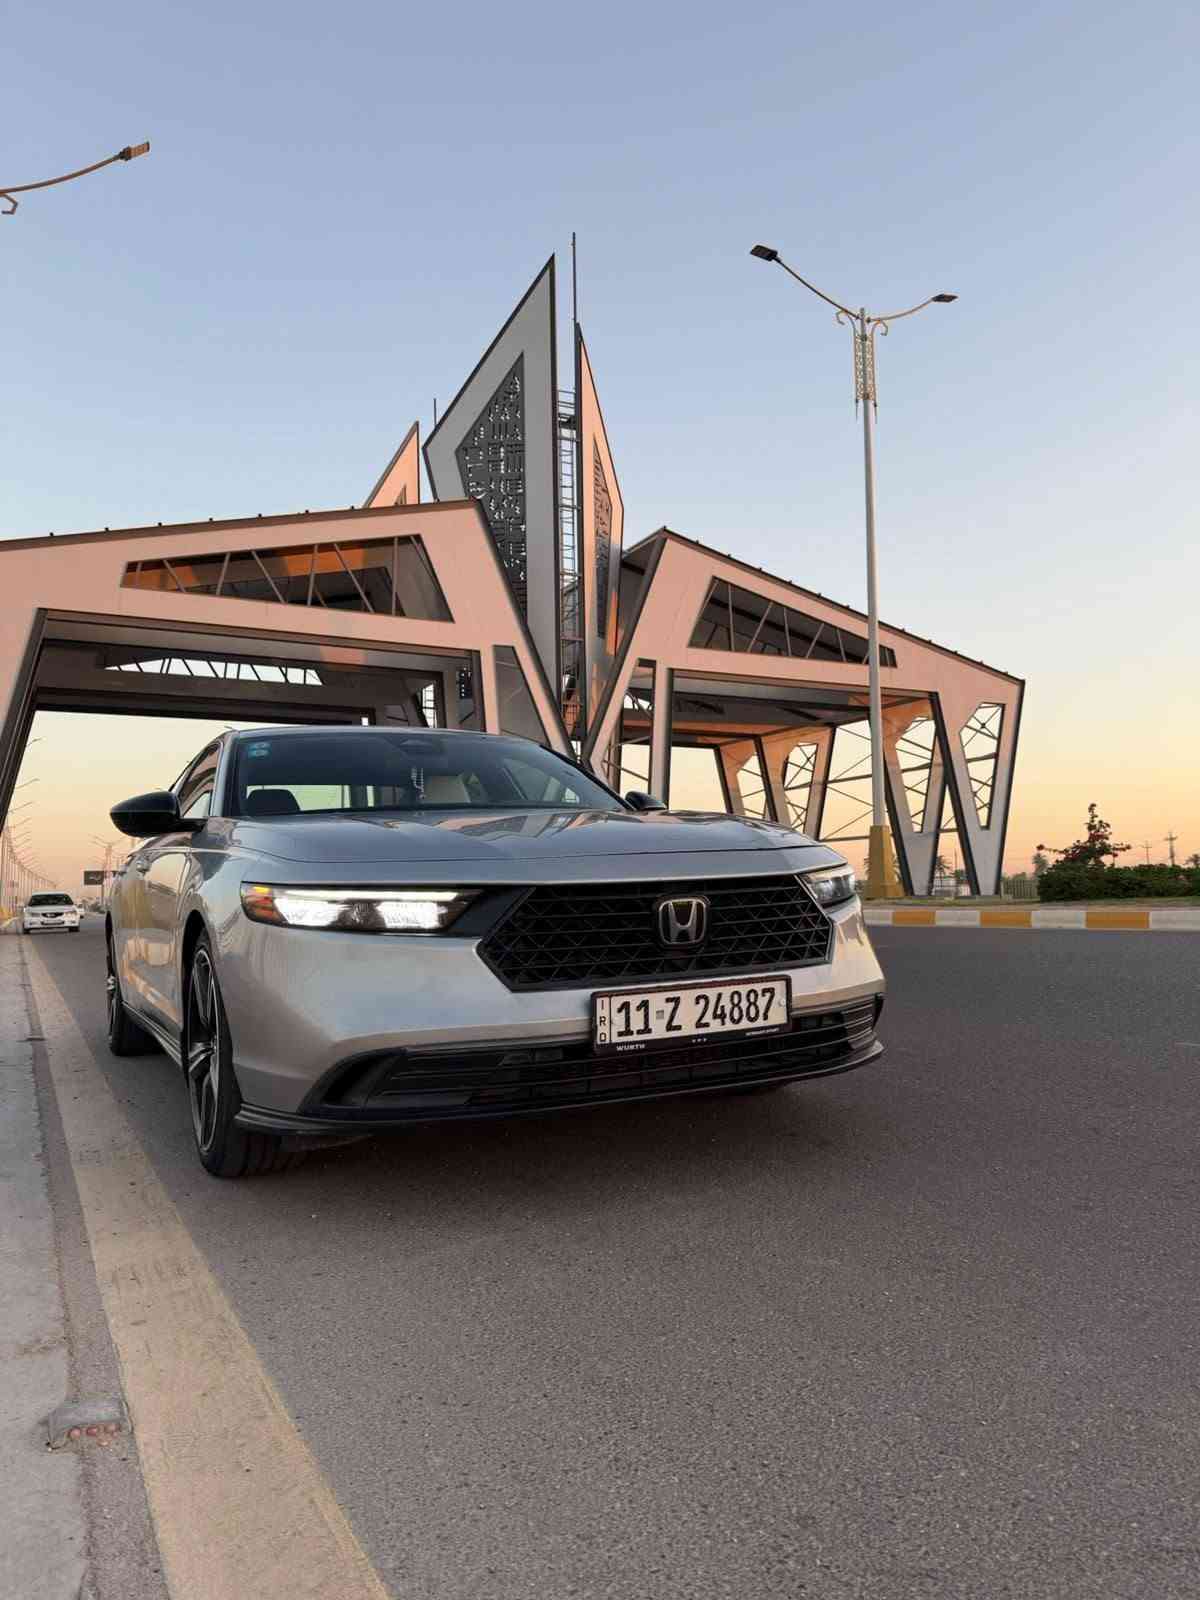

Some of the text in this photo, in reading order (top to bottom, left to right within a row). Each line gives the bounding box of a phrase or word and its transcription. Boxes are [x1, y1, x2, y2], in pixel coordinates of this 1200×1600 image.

[616, 987, 776, 1037] 11 Z 24887
